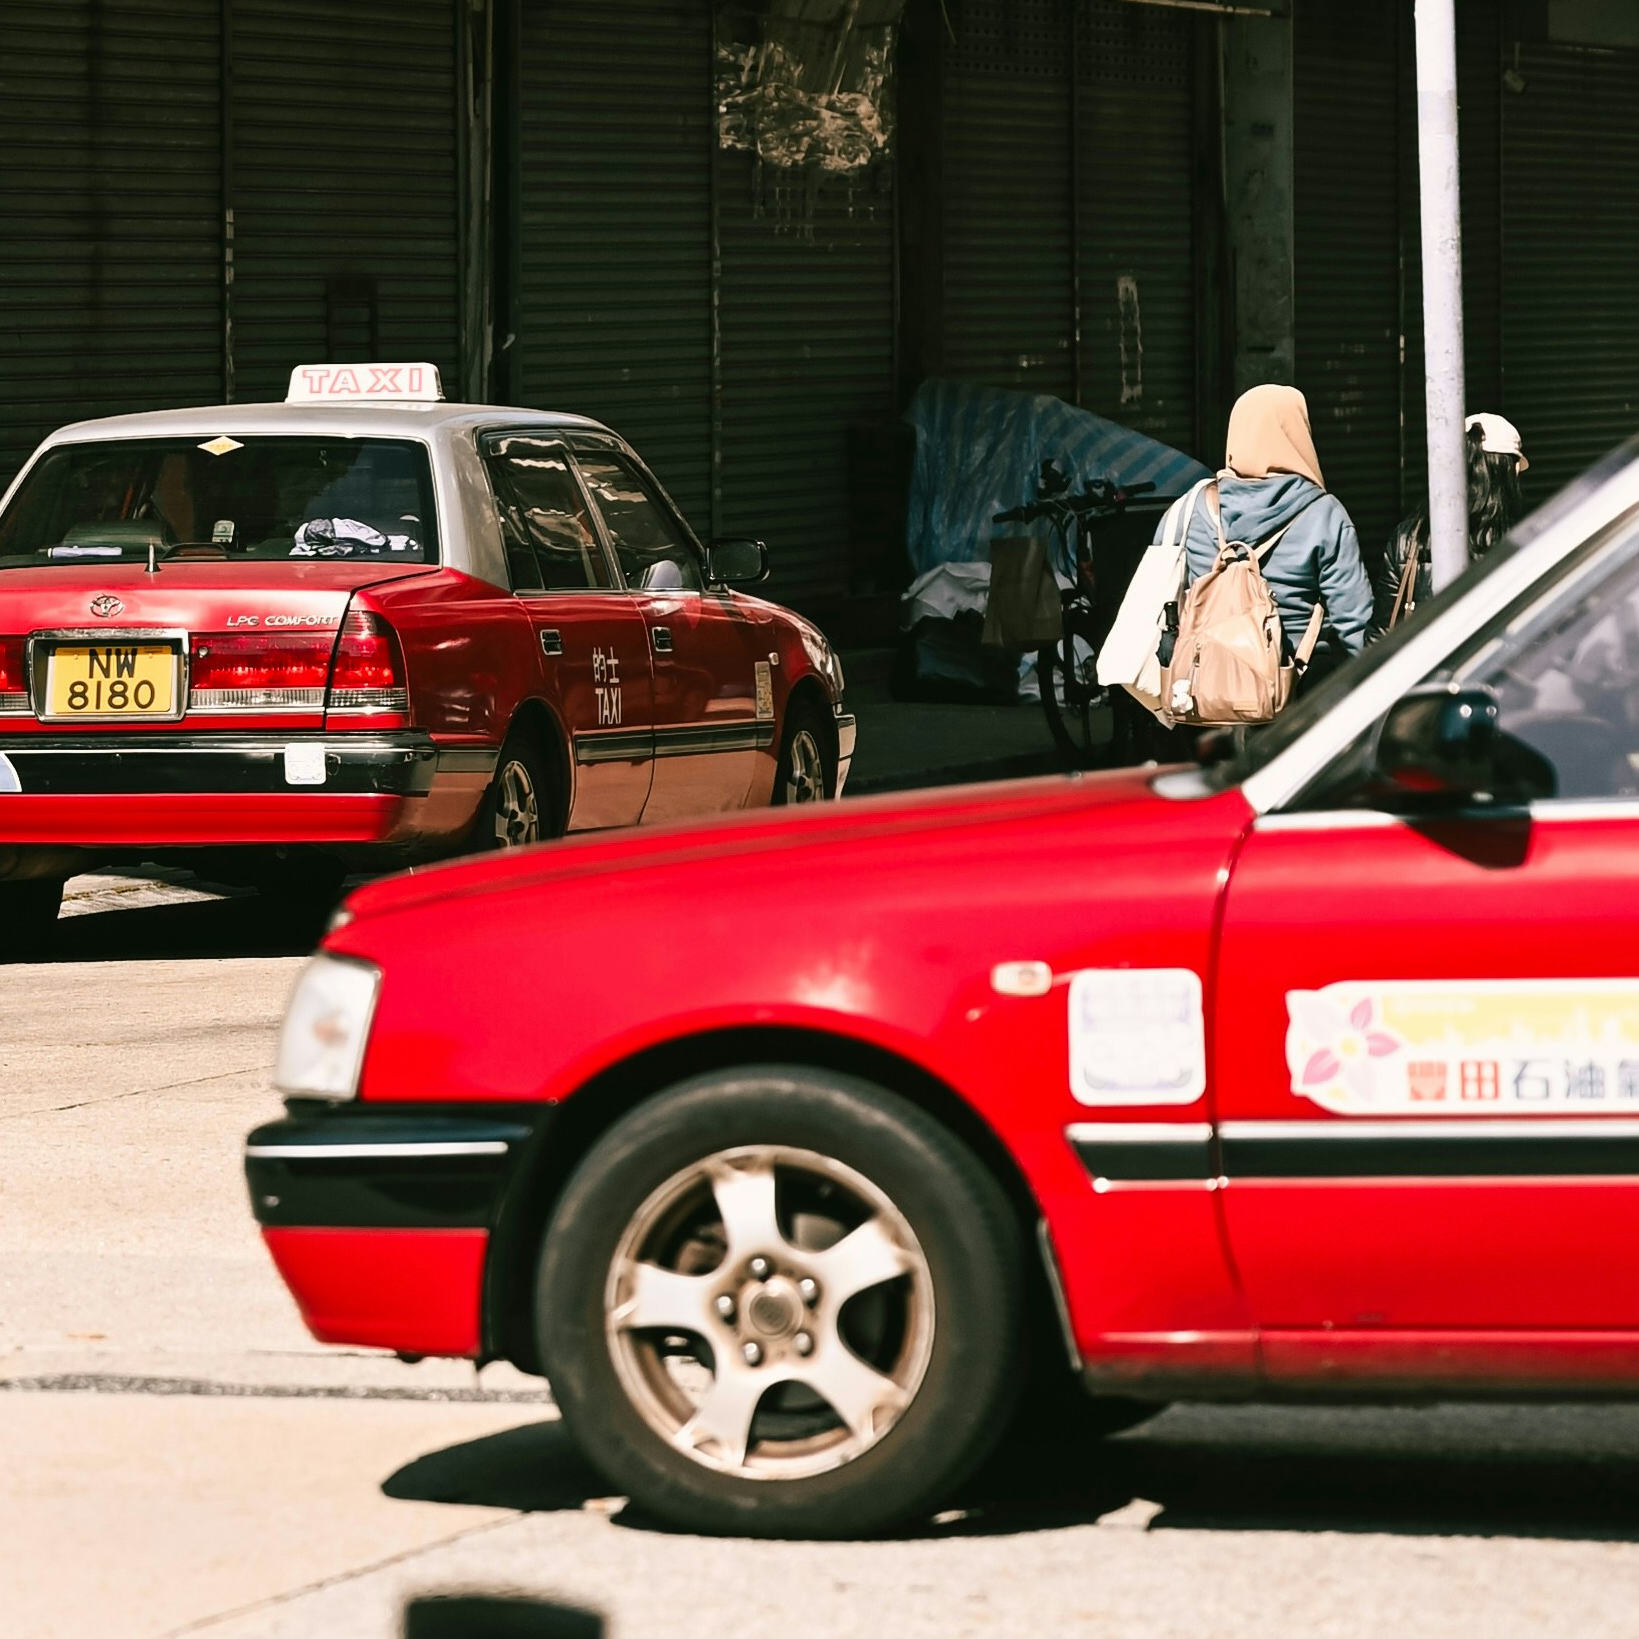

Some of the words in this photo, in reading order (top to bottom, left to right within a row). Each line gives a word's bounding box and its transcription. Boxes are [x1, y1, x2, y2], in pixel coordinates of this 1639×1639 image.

[301, 367, 423, 394] TAXI
[226, 615, 260, 628] LPG
[264, 615, 339, 627] COMFORT
[89, 647, 138, 679] NW
[593, 646, 621, 684] 的士
[68, 679, 156, 710] 8180
[595, 687, 622, 725] TAXI
